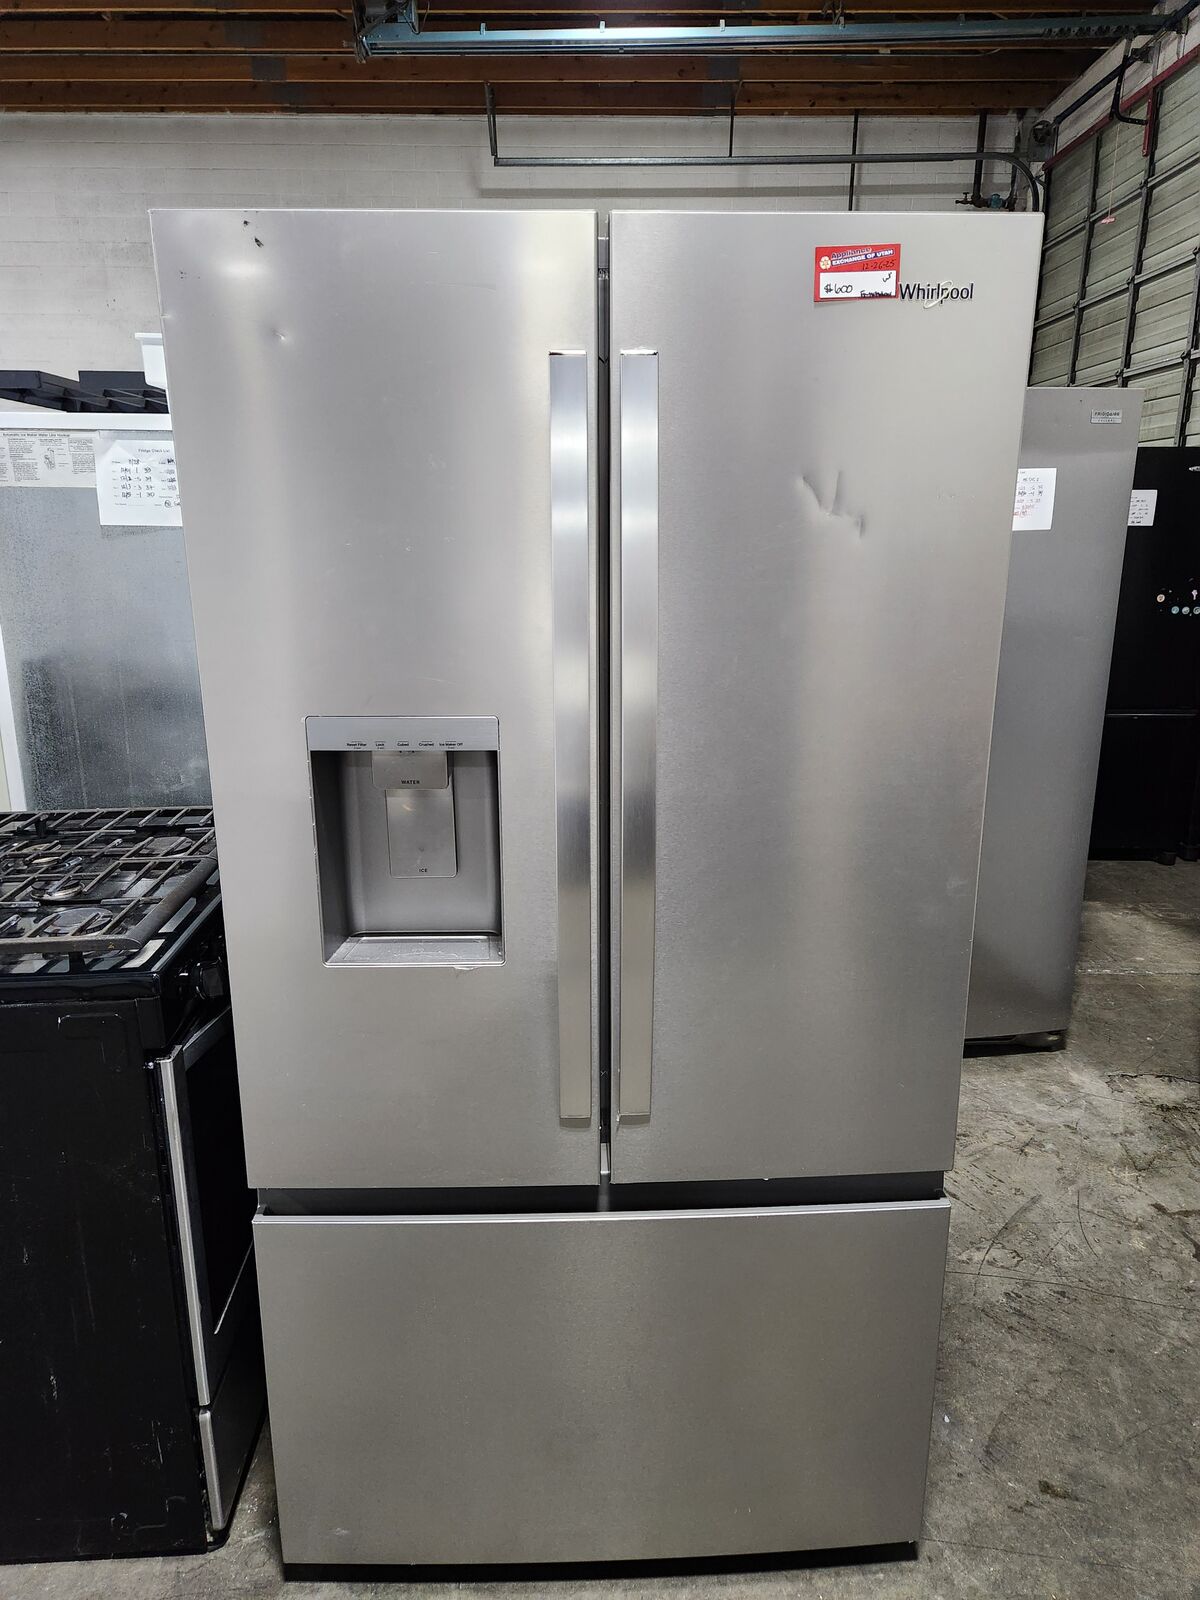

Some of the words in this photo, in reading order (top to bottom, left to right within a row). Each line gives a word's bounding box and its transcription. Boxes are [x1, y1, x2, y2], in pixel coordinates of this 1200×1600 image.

[831, 247, 873, 259] Appliance
[832, 254, 866, 266] EXCHANGE
[877, 249, 894, 257] UTAH
[862, 259, 896, 271] 12-26-25
[823, 283, 854, 295] $600
[899, 283, 974, 304] Whirlpool
